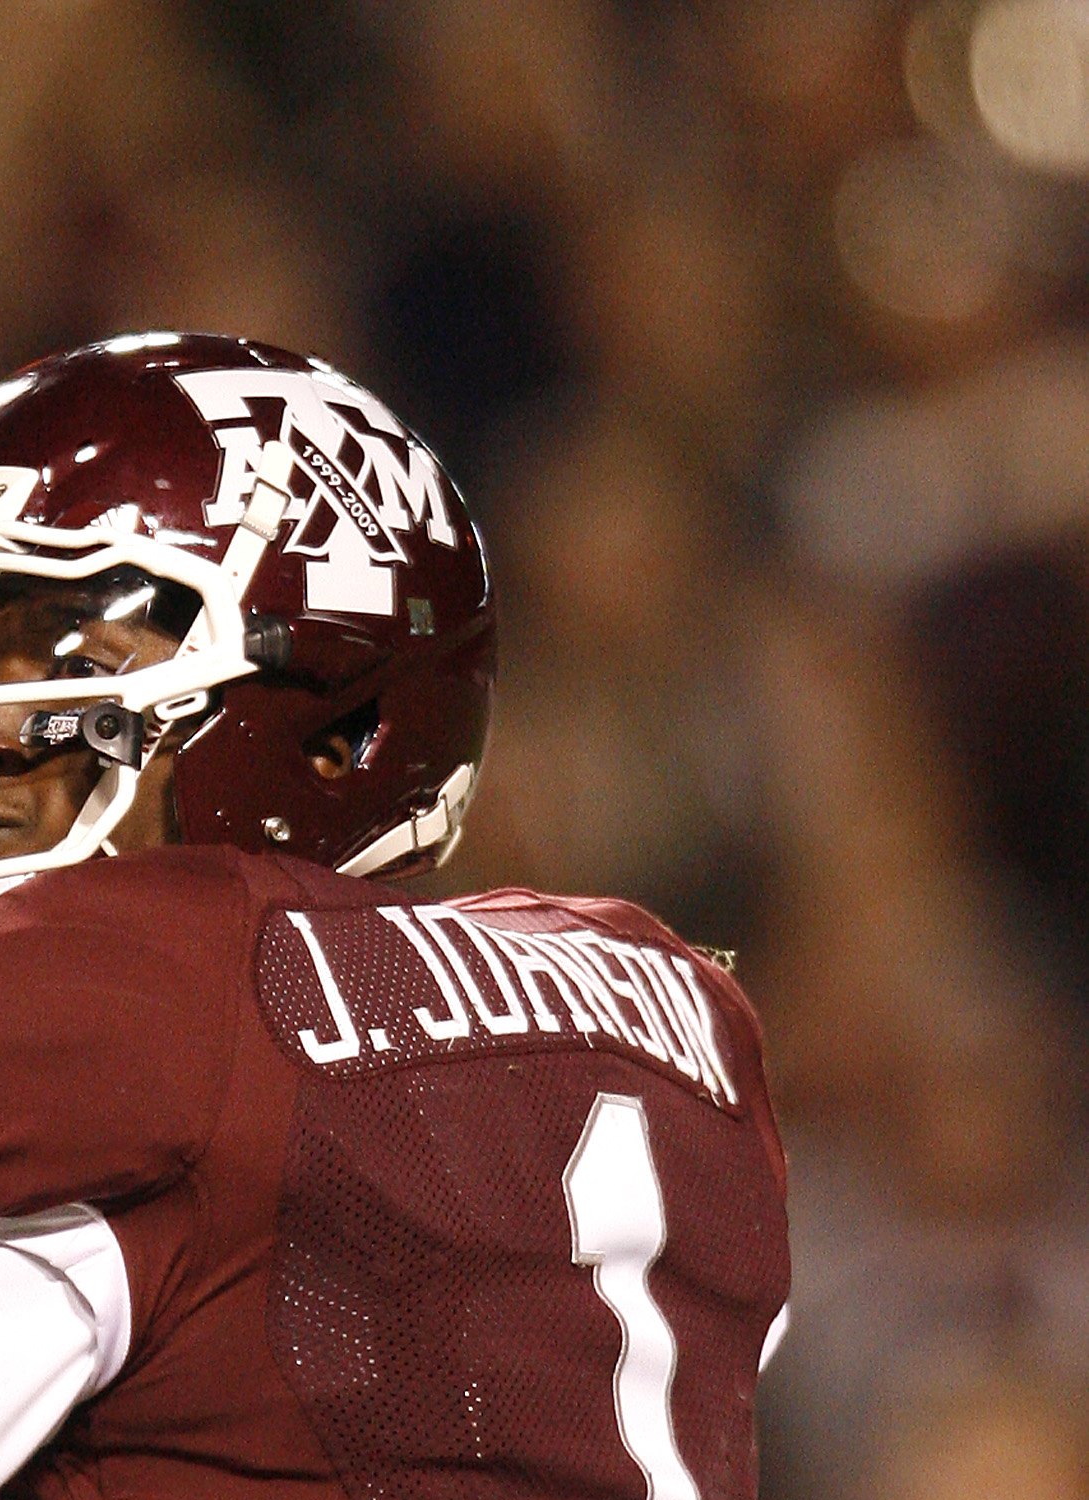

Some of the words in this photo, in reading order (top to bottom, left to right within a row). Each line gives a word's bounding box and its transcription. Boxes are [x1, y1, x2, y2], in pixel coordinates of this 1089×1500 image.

[302, 445, 379, 537] 1999-2009
[286, 909, 390, 1064] J.
[377, 904, 738, 1105] JOHNSON
